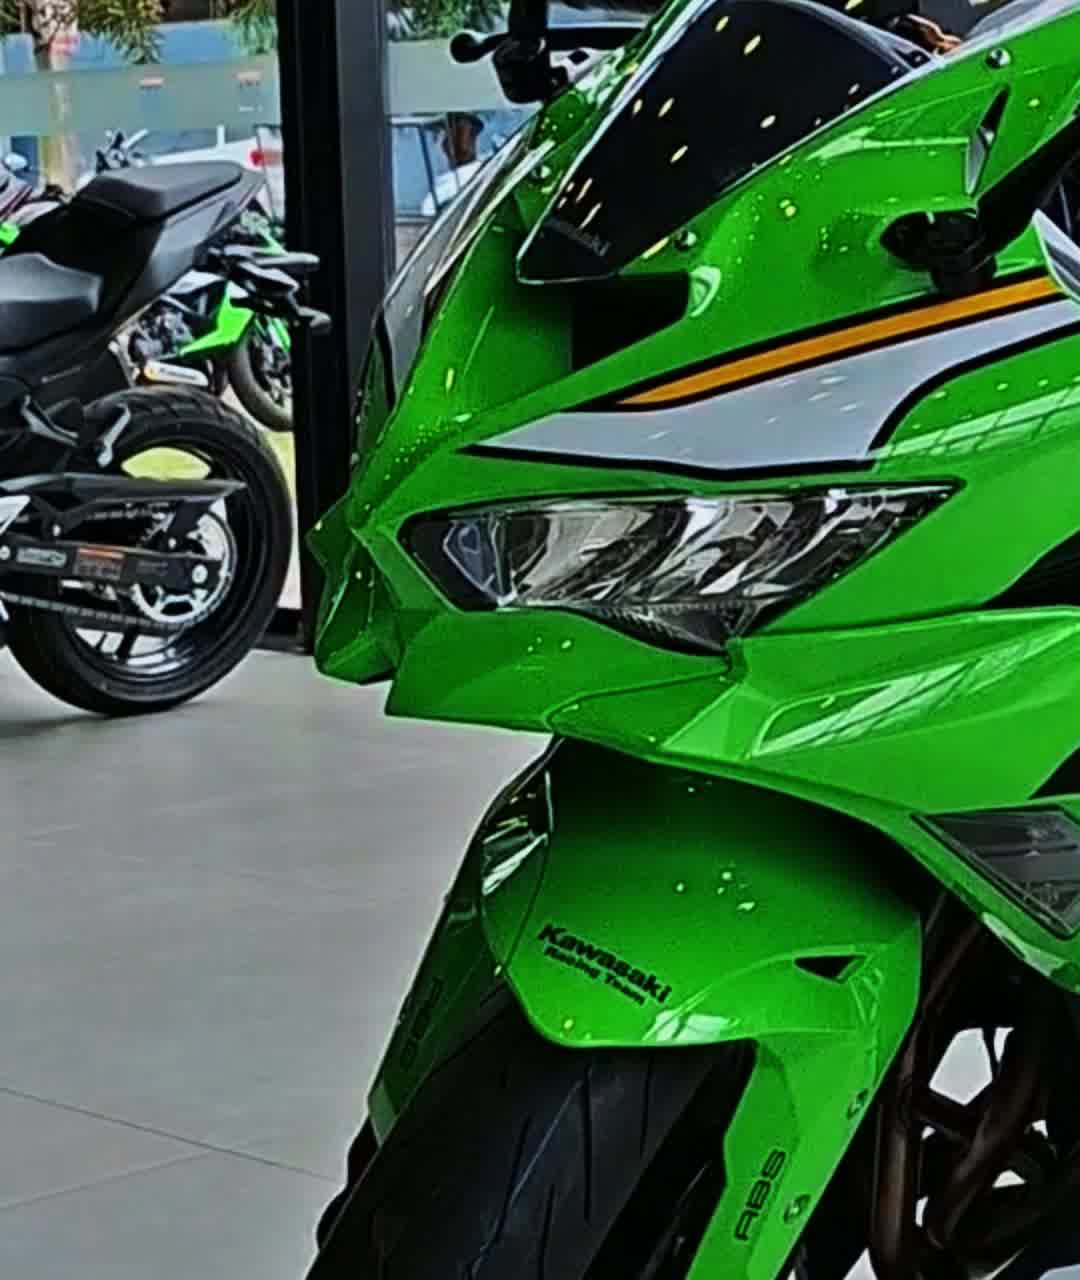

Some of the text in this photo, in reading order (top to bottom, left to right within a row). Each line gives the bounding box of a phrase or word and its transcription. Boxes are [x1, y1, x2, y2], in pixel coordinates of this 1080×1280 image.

[538, 924, 672, 1003] Kawasaki
[544, 946, 646, 1006] Racing Team
[735, 1149, 786, 1241] ABS
